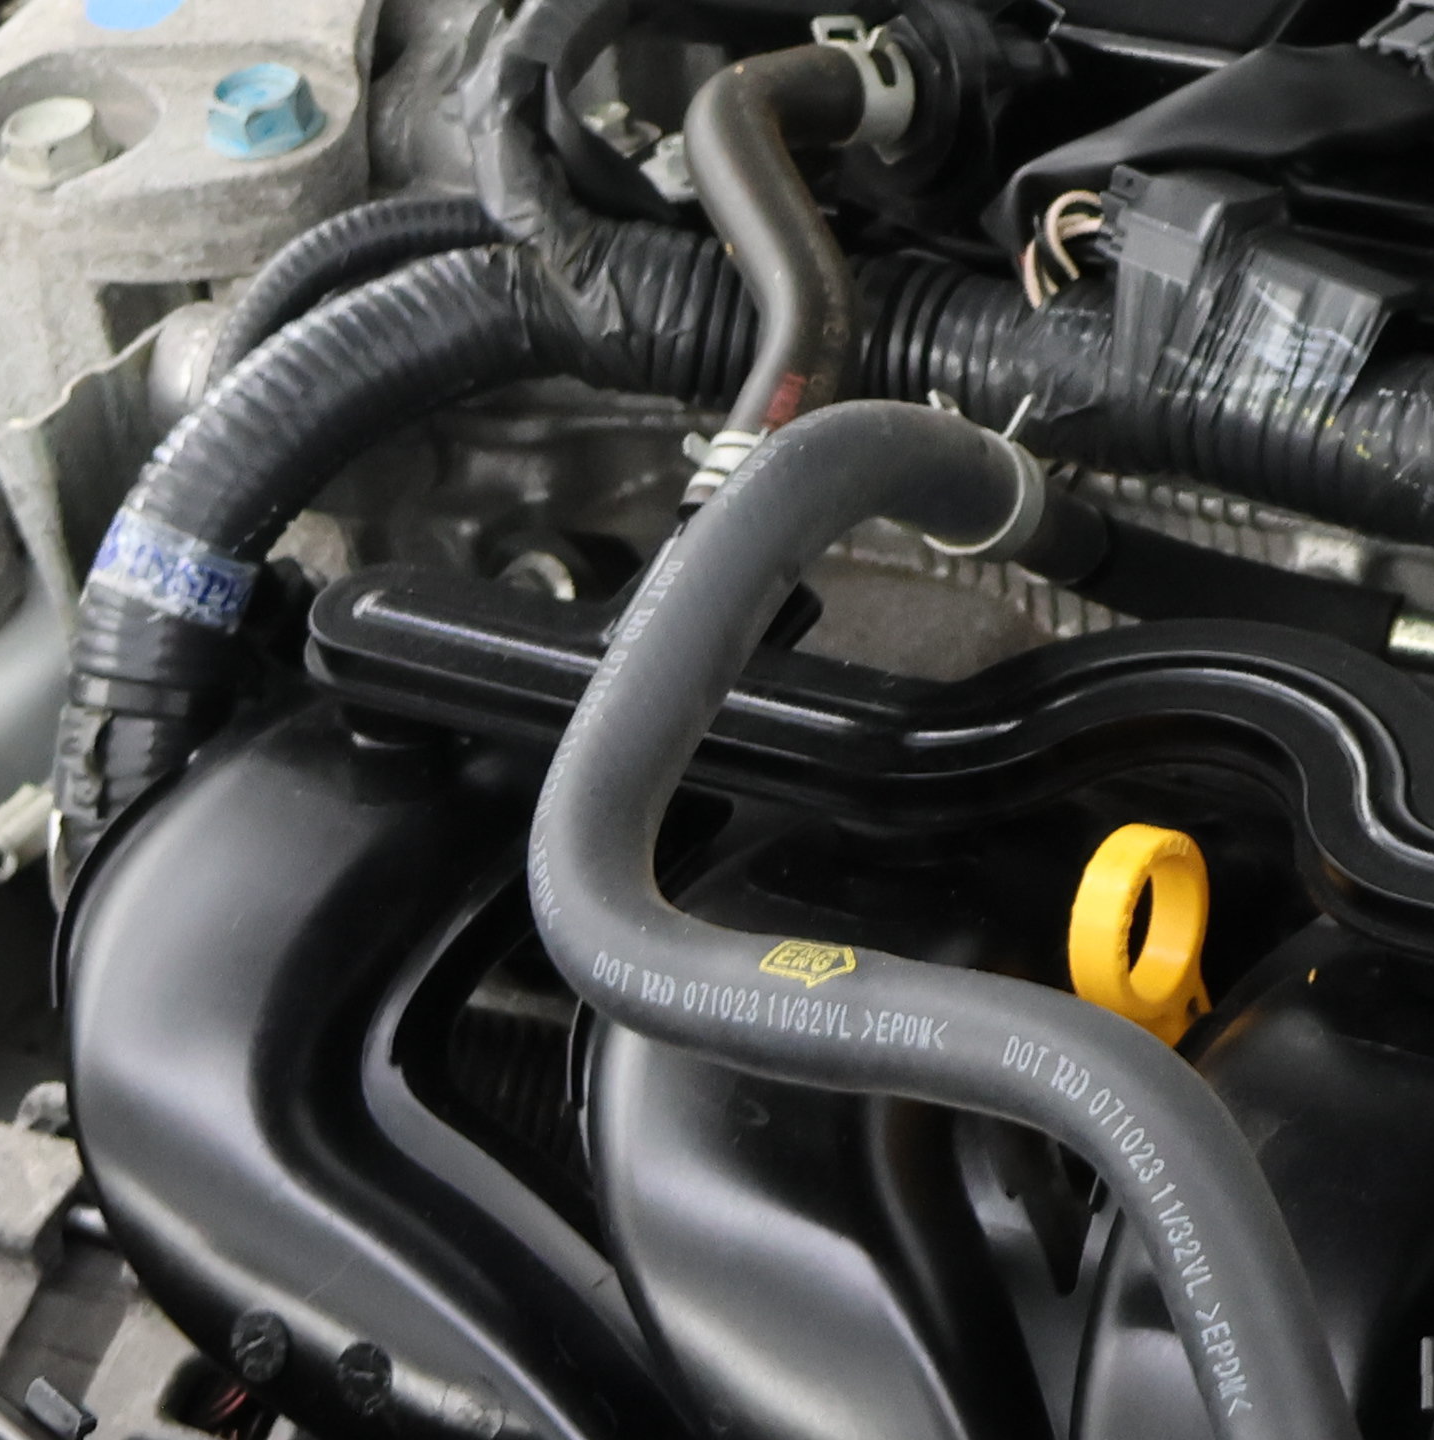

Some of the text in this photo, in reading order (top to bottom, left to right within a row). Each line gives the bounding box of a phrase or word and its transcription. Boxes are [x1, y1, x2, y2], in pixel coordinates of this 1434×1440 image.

[591, 950, 635, 994] DOT
[682, 980, 761, 1025] 071023
[1002, 1035, 1050, 1080] DOT
[1088, 1088, 1166, 1184] 071023
